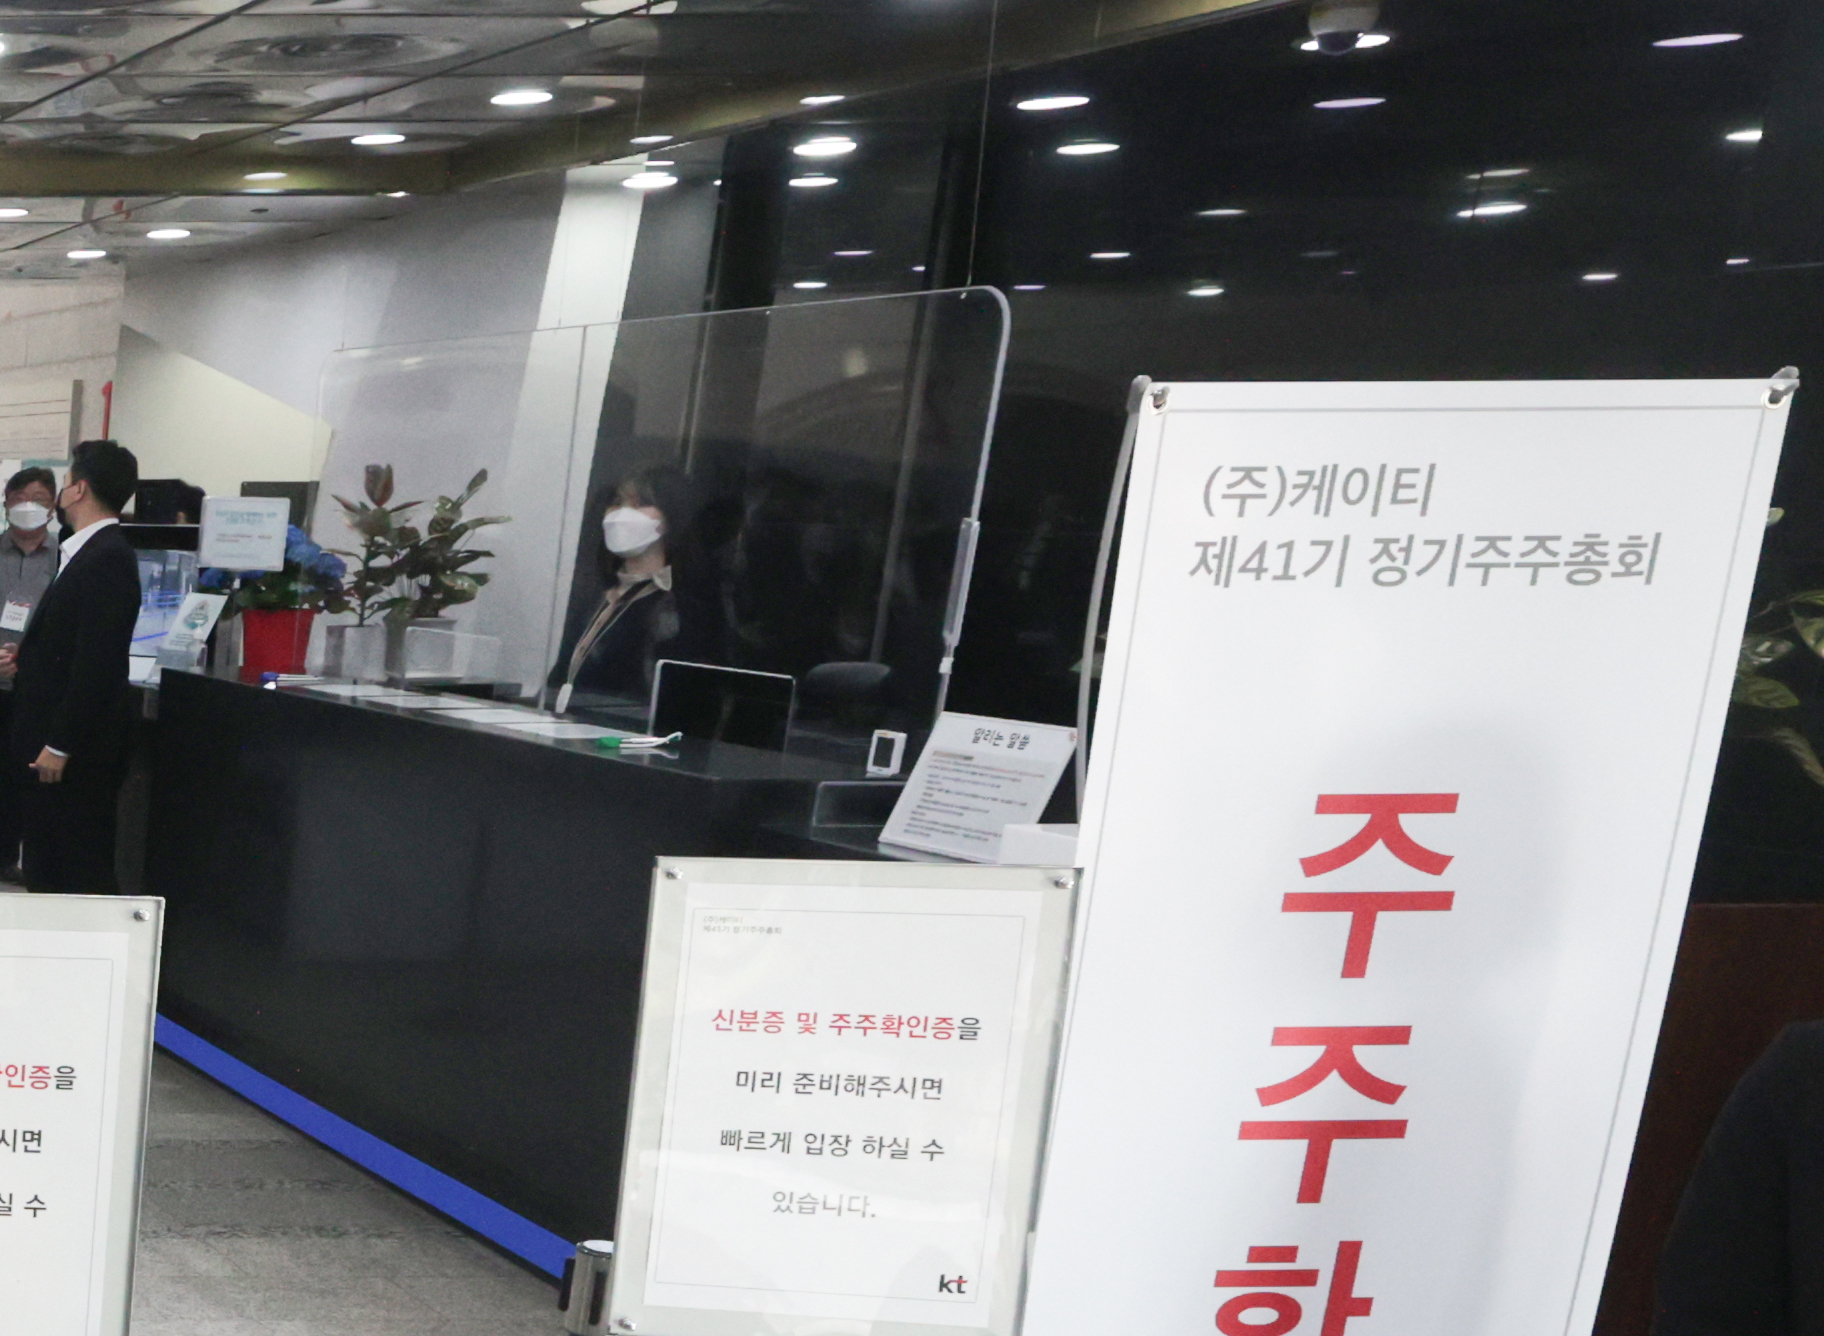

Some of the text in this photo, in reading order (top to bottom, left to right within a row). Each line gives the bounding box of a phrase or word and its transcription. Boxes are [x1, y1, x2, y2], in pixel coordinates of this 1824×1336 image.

[1203, 462, 1437, 519] (주)케이티
[1188, 531, 1663, 589] 제41기 정기주주총회
[711, 1008, 982, 1041] 신분증 및 주주확인증을
[735, 1070, 943, 1101] 미리 준비해주시면
[719, 1129, 945, 1162] 빠르게 입장 하실 수
[23, 1194, 47, 1219] 수
[771, 1190, 877, 1219] 있습니다.
[938, 1273, 968, 1295] kt
